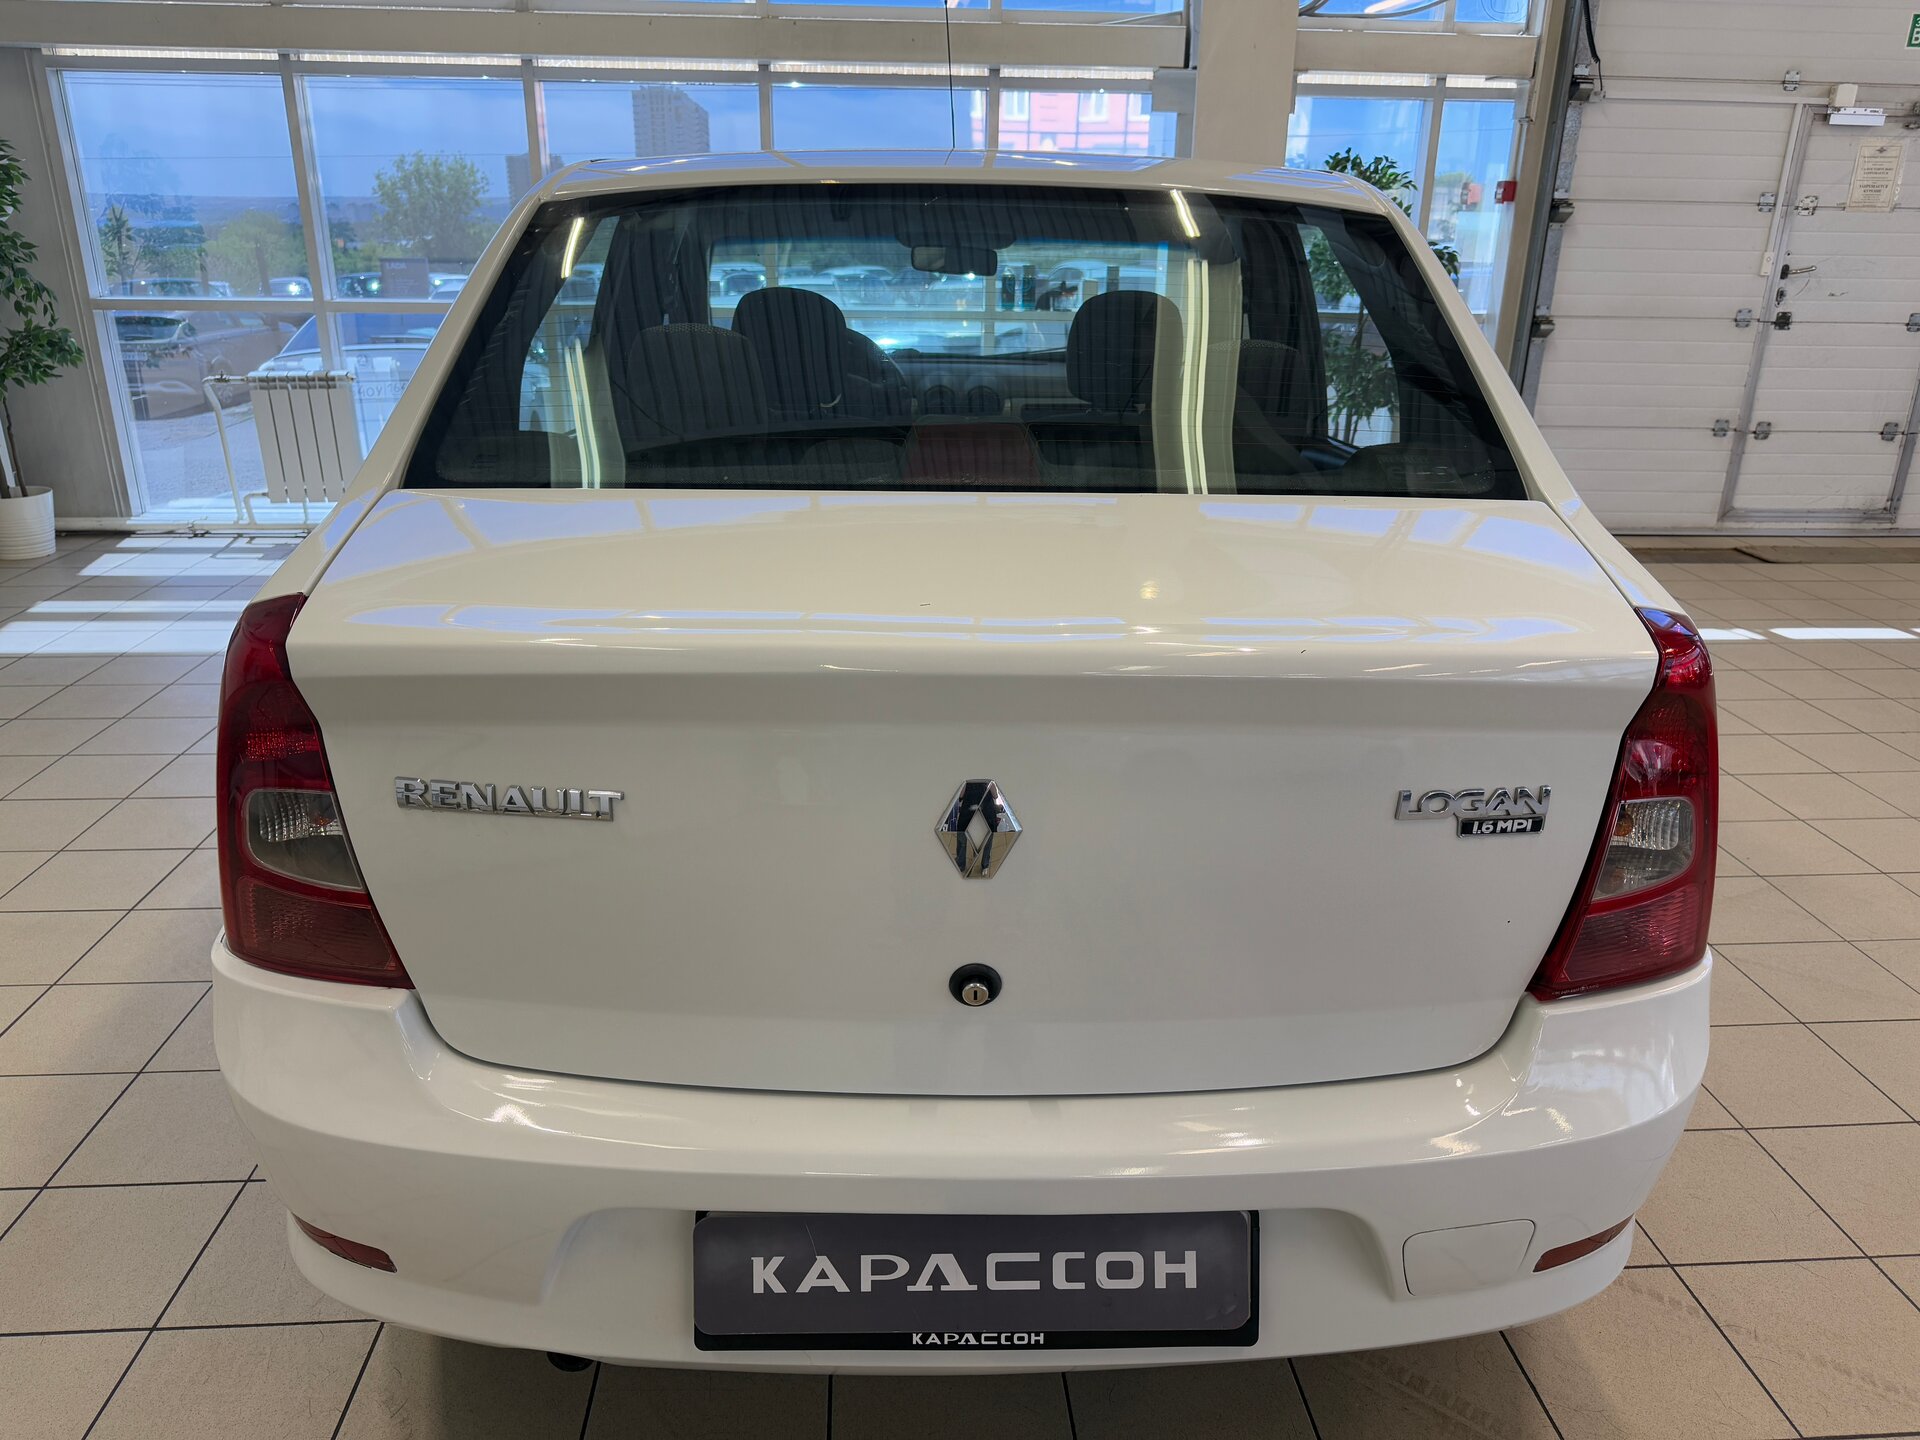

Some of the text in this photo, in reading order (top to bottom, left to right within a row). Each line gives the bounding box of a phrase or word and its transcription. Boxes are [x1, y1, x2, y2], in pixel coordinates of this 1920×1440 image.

[395, 776, 624, 821] RENAULT
[1395, 785, 1552, 820] LOGAN
[1472, 818, 1533, 834] 1.6 MPI
